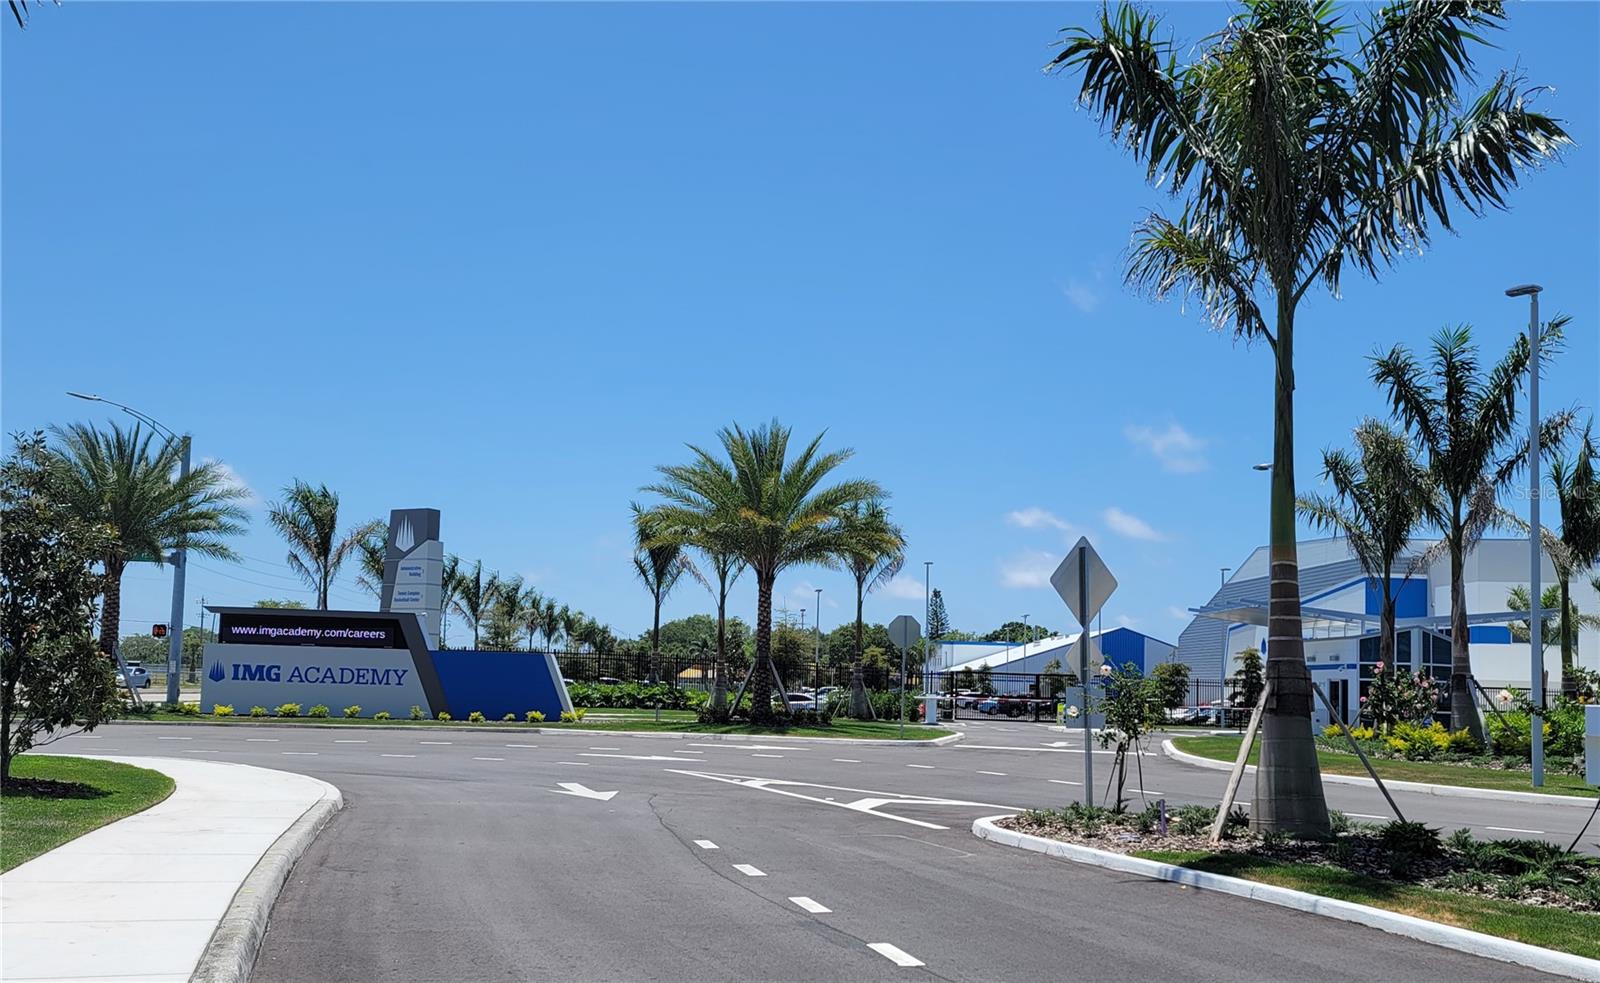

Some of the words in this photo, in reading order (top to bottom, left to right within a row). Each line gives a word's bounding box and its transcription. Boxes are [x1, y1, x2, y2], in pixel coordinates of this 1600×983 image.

[231, 625, 386, 640] www.imgacademy.com/careers
[231, 664, 281, 682] IMG
[286, 666, 408, 686] ACADEMY
